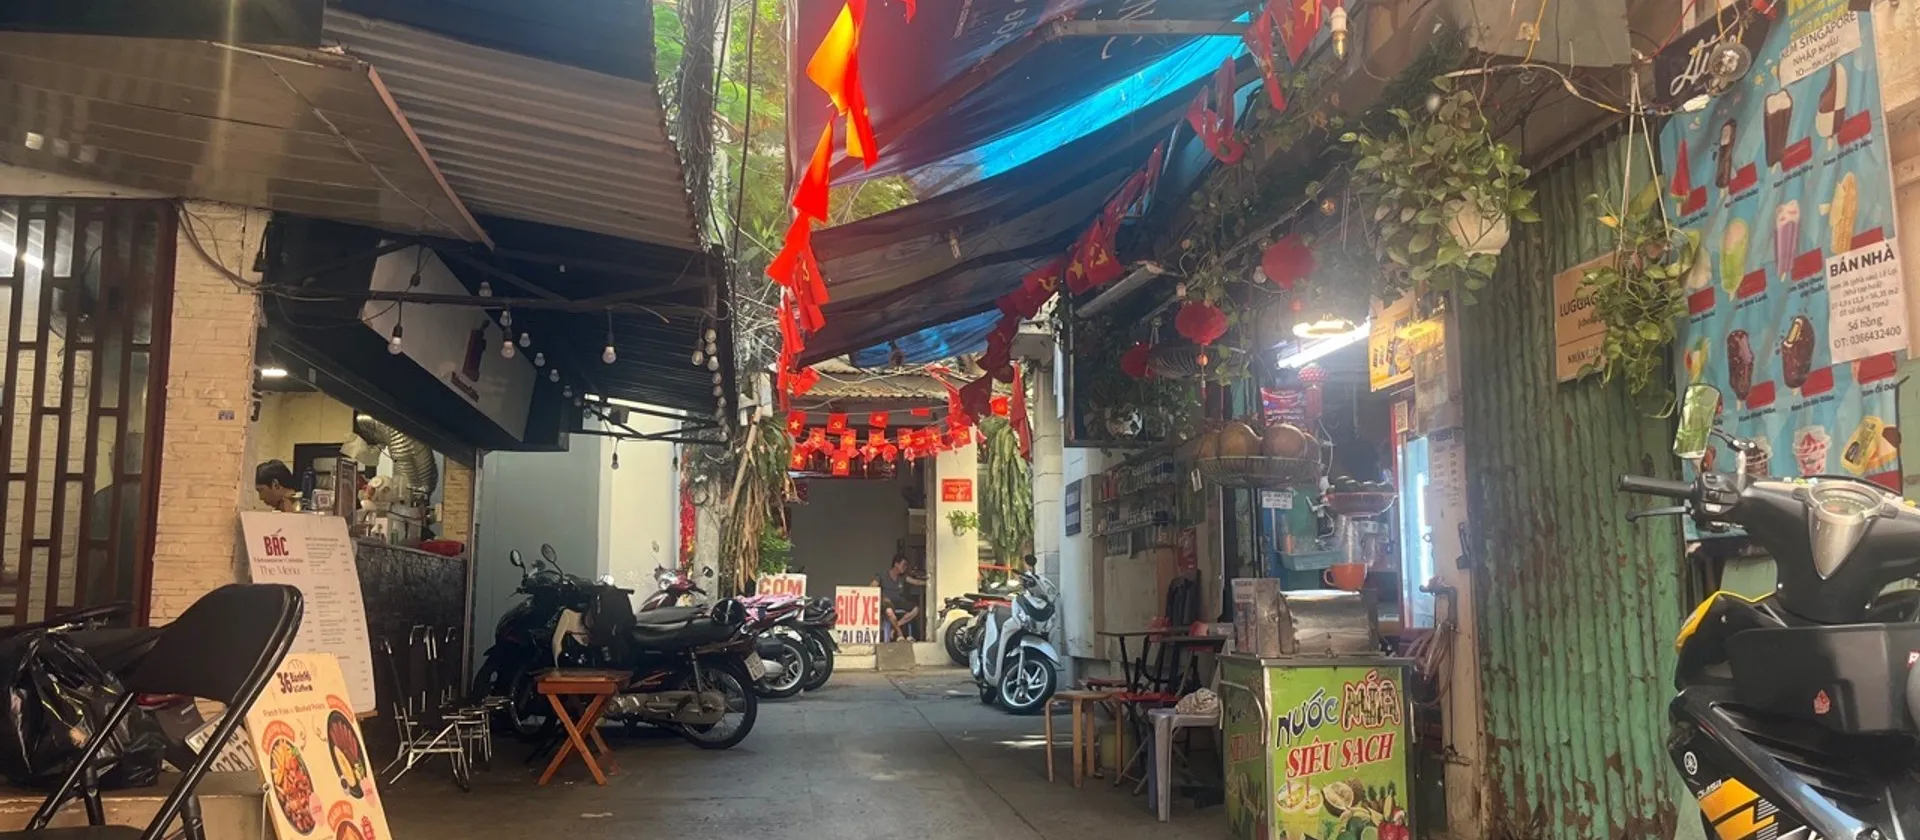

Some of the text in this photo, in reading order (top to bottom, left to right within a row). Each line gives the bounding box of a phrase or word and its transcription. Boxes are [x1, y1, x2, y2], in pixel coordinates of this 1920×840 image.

[1799, 11, 1857, 50] SINGAPORE
[1830, 243, 1895, 277] BÁN NHÀ
[1559, 291, 1598, 317] LUGGAG
[259, 565, 301, 576] The Menu
[758, 575, 803, 596] CƠM
[836, 590, 879, 626] GIỮ XE
[1276, 687, 1339, 750] NƯỚC
[1286, 736, 1339, 779] SIÊU
[1341, 733, 1396, 772] SẠCH
